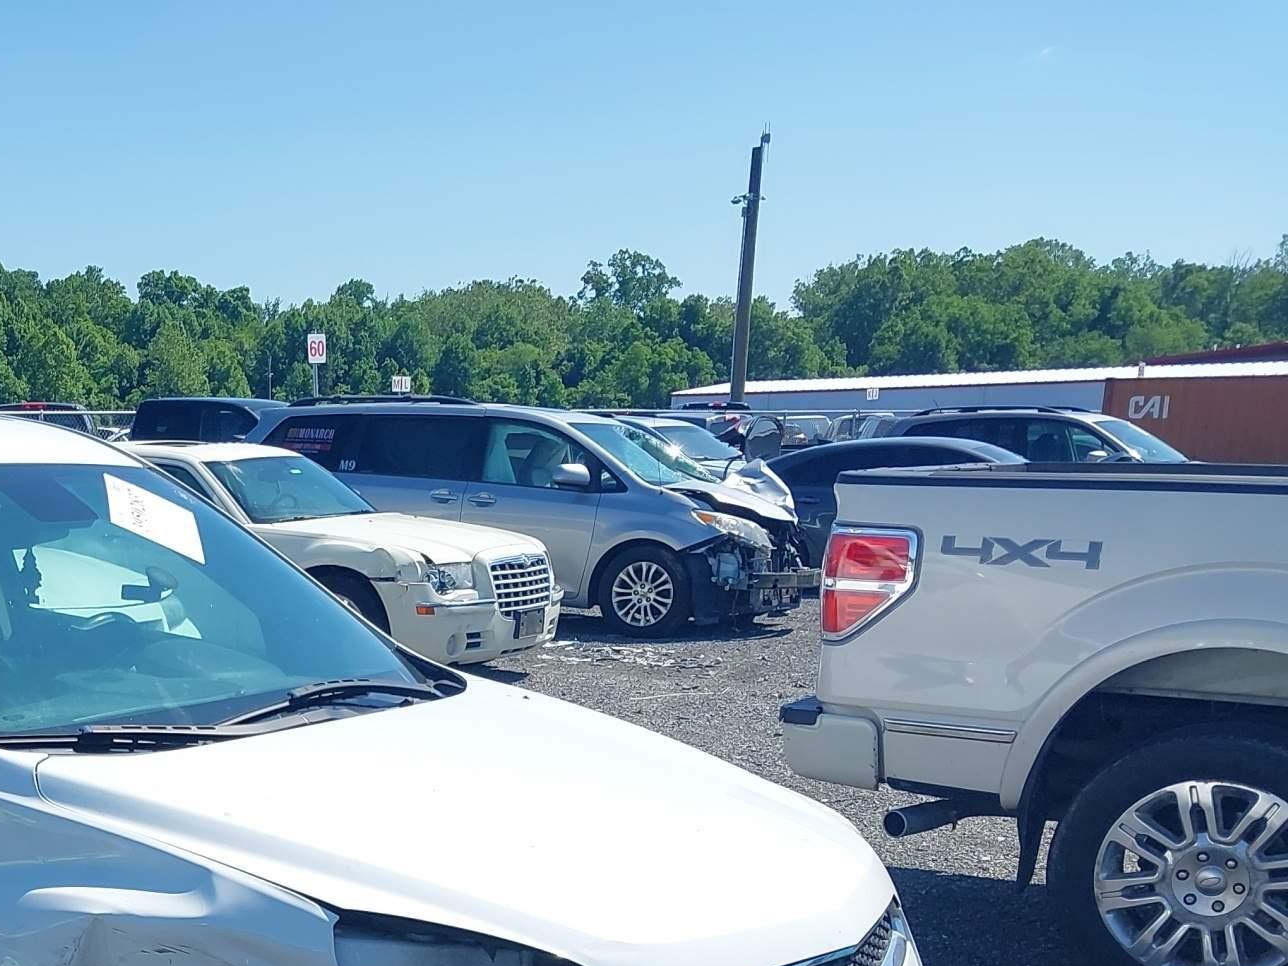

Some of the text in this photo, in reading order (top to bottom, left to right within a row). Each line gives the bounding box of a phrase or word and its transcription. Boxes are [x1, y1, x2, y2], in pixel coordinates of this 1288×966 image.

[309, 340, 325, 357] 60
[1128, 395, 1170, 419] CAI
[339, 459, 357, 472] M9
